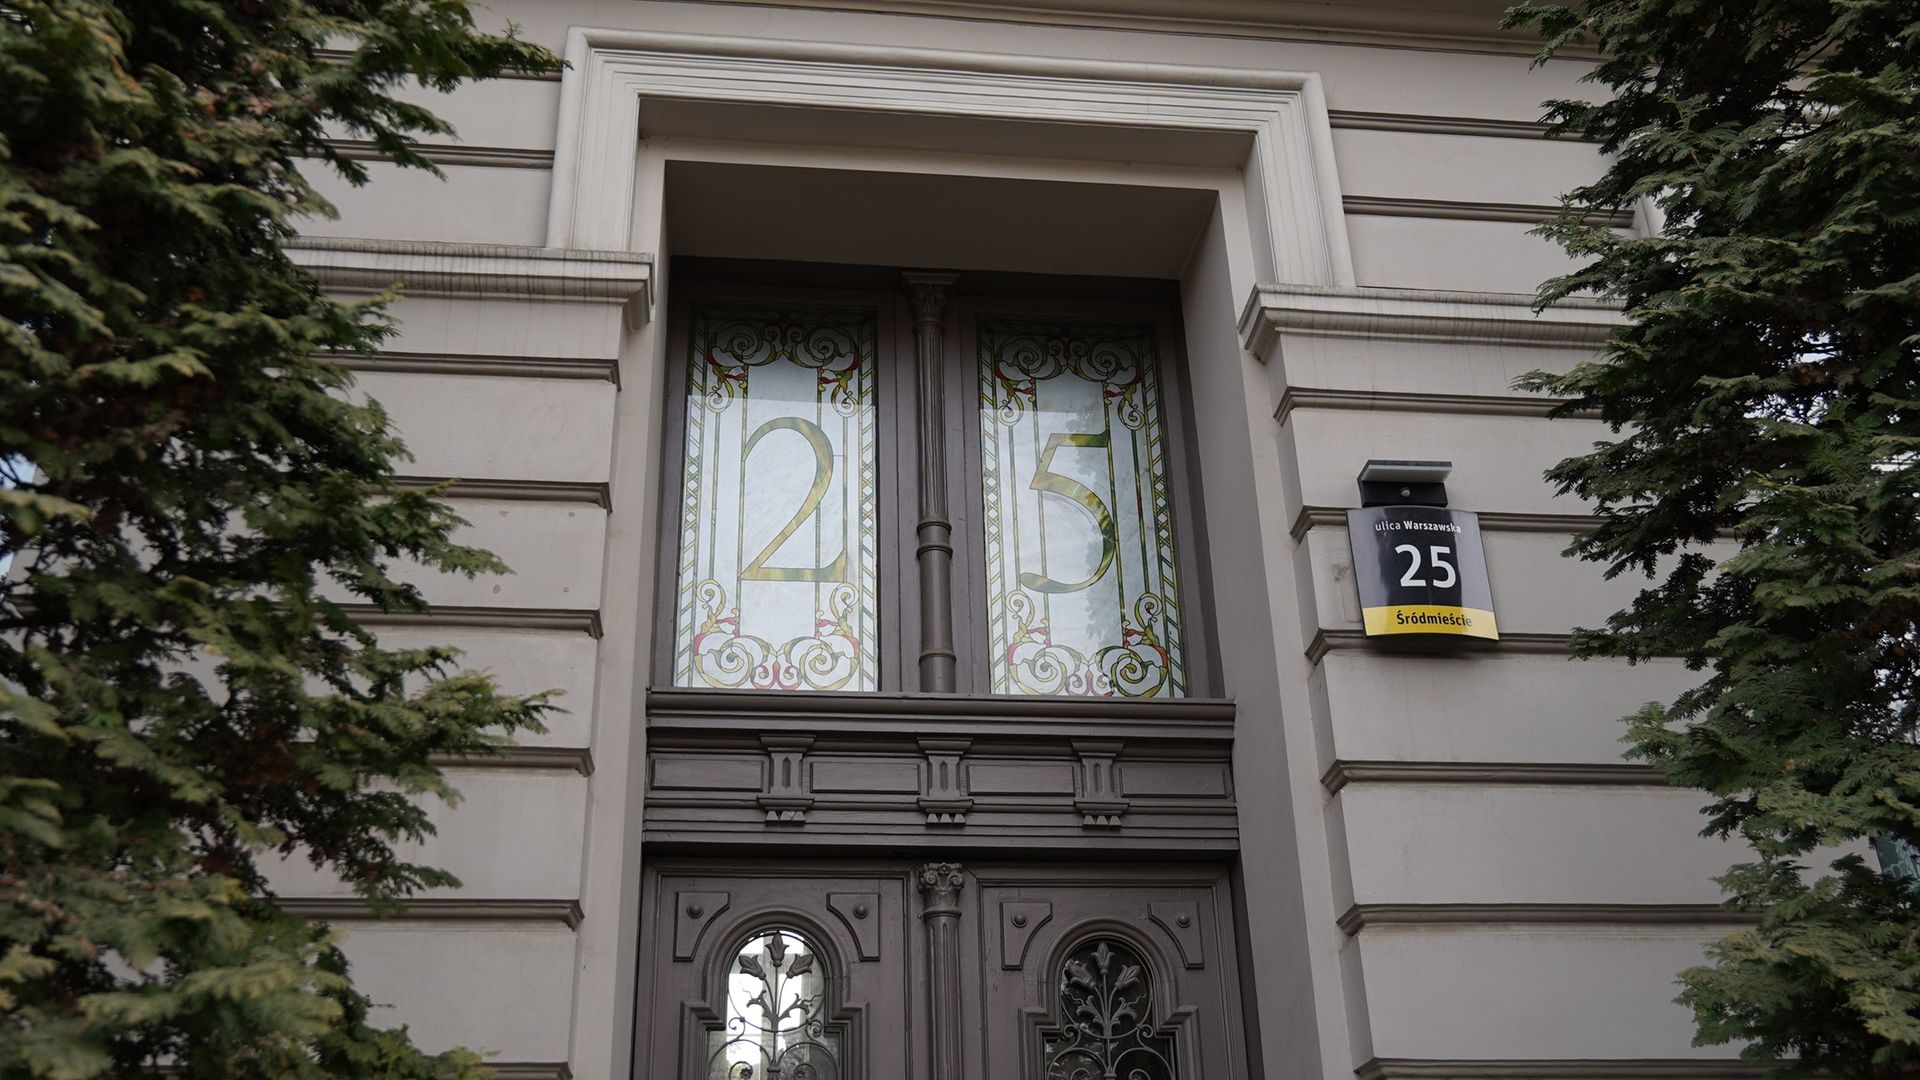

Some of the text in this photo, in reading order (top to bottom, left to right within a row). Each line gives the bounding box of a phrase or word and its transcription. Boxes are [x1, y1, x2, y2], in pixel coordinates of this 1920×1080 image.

[1375, 521, 1461, 534] ulica Warszawska
[1395, 544, 1456, 588] 25
[1397, 610, 1472, 626] Śródmieście
